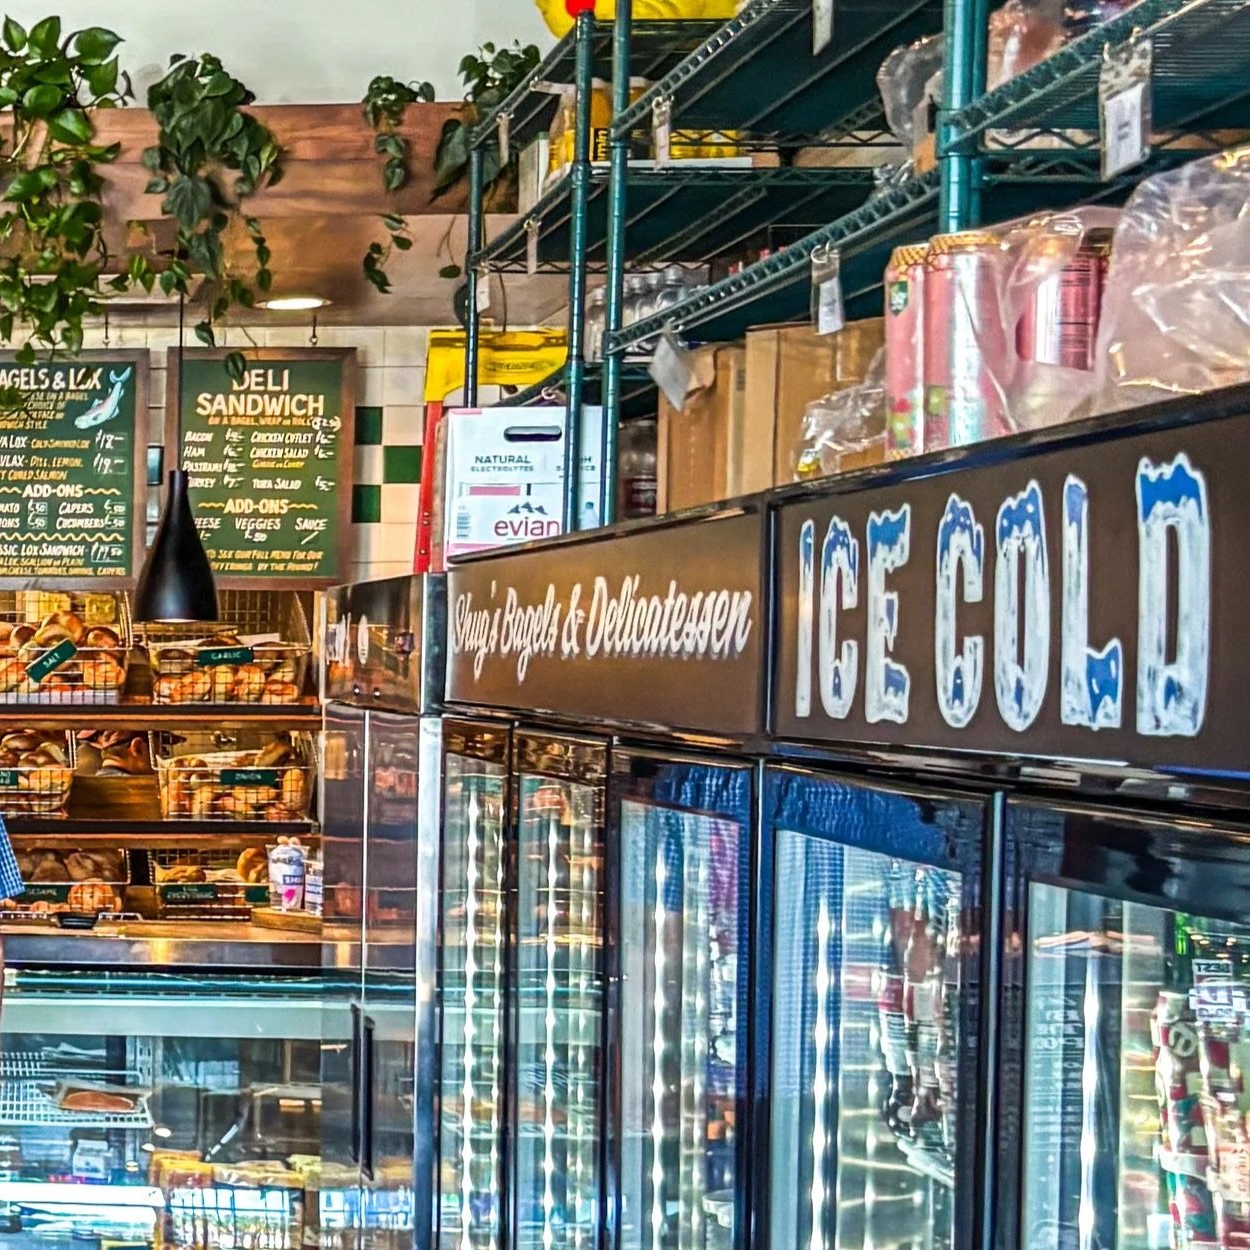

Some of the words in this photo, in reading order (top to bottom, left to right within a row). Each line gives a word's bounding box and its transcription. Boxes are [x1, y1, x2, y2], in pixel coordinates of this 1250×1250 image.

[52, 371, 66, 390] &
[232, 369, 290, 391] DELI
[196, 392, 325, 416] SANDWICH
[9, 435, 28, 448] LOX
[184, 430, 214, 443] BACON
[250, 431, 285, 444] CHICKEN
[285, 431, 314, 444] CUTLET
[183, 446, 206, 458] HAM
[249, 447, 283, 460] CHICKEN
[283, 447, 309, 459] SALAD
[182, 460, 223, 473] PASTRAMI
[475, 455, 532, 464] NATURAL
[33, 469, 68, 481] SALMON
[187, 476, 216, 489] TURKEY
[274, 476, 302, 490] SALAD
[21, 483, 85, 498] ADD-ONS
[58, 501, 94, 514] CAPERS
[223, 498, 289, 514] ADD-ONS
[55, 516, 105, 530] CUCUMBERS
[235, 517, 282, 531] VEGGIES
[294, 517, 328, 531] SAUCE
[494, 516, 561, 537] evian
[20, 543, 39, 556] LOX
[39, 542, 85, 556] SANDWICH
[796, 500, 913, 726] ICE
[934, 450, 1213, 739] COLD
[501, 585, 562, 686] Bagels
[562, 583, 586, 657] &
[586, 573, 752, 658] Delicatessen
[43, 652, 61, 668] SALT
[211, 651, 241, 660] GARLIC
